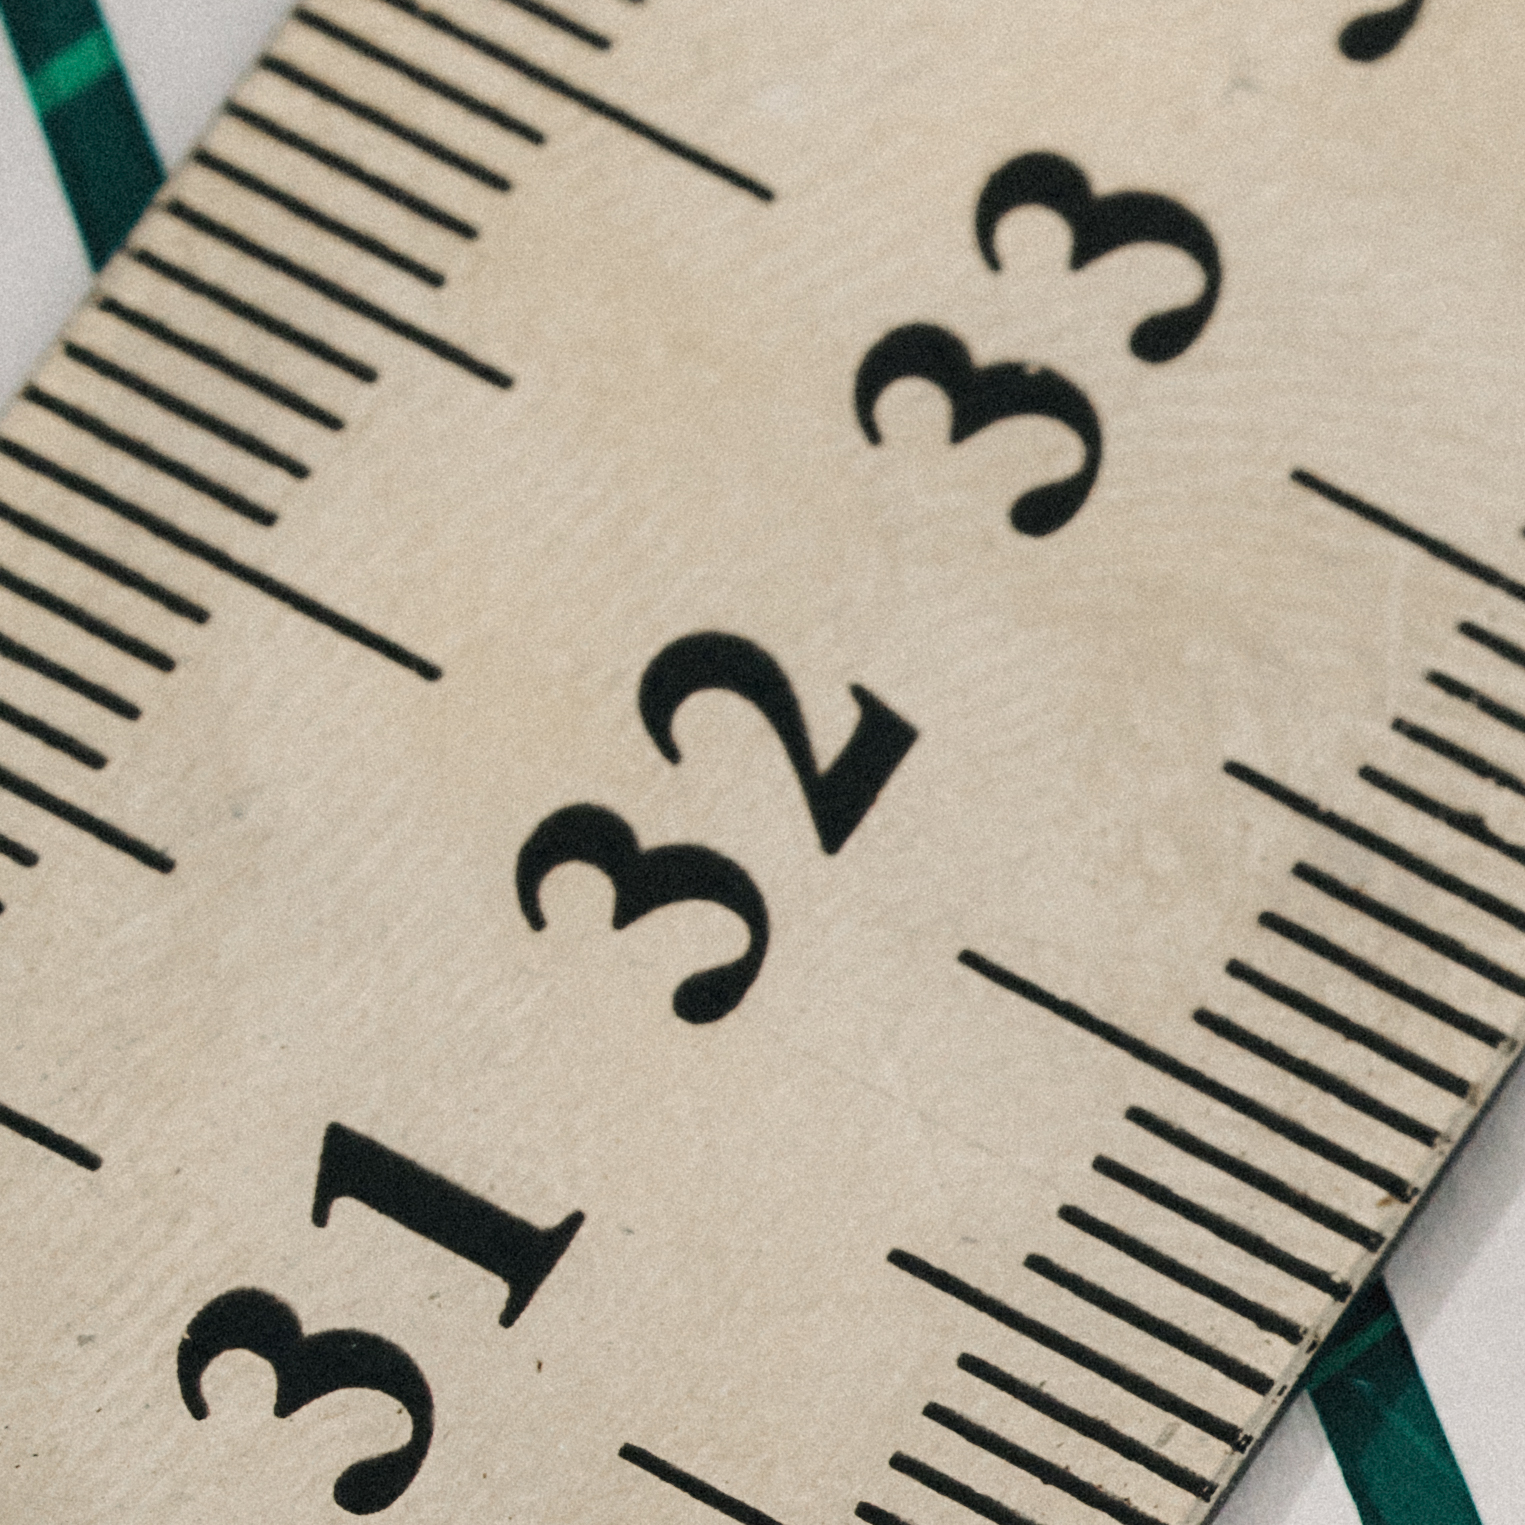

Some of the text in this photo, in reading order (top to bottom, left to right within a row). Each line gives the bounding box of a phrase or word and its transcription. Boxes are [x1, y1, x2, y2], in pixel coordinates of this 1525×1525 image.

[852, 150, 1223, 538] 33
[514, 629, 919, 1026] 32
[175, 1121, 586, 1517] 31
